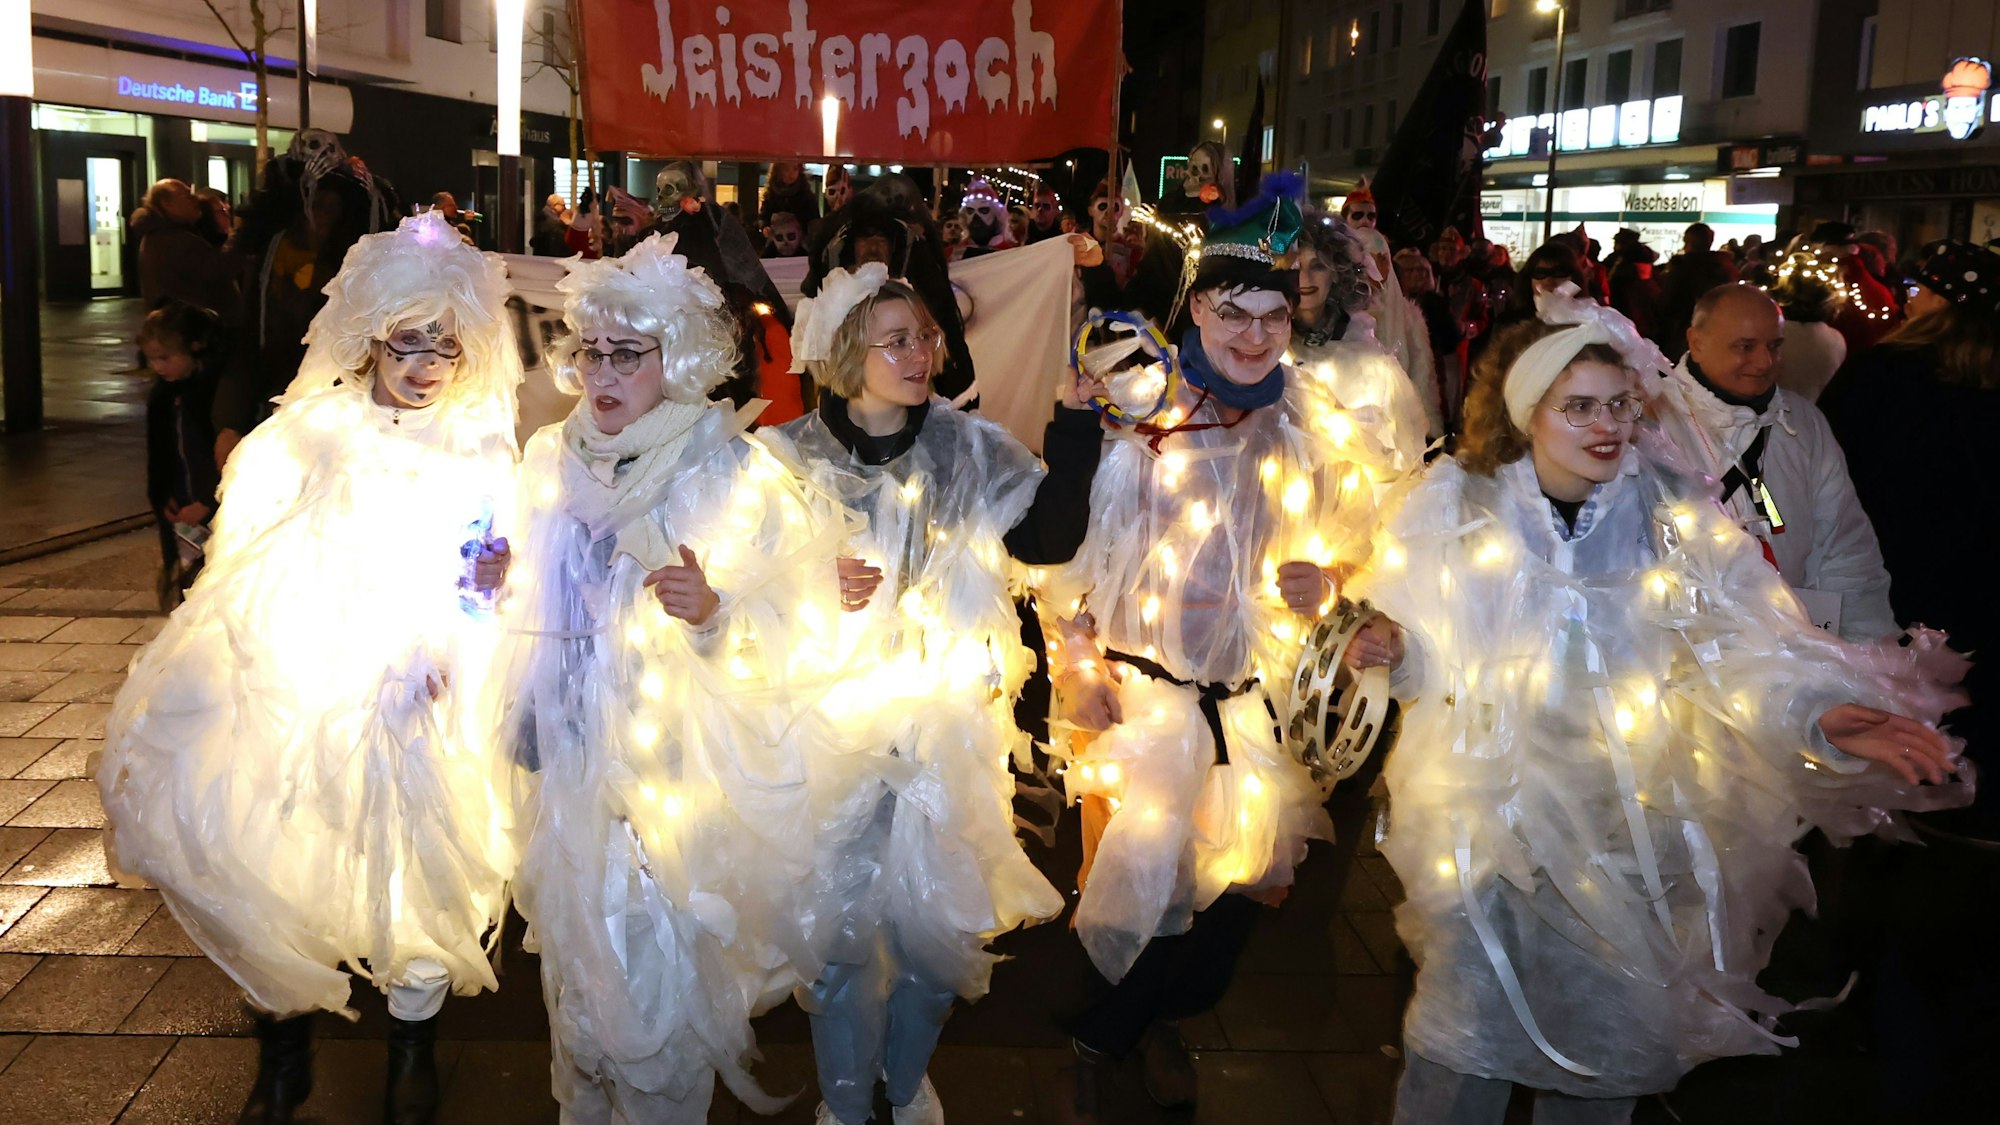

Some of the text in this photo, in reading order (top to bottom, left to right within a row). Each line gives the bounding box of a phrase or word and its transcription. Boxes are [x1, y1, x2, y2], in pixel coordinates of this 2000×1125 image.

[641, 0, 1057, 143] Jeisterzoch
[118, 76, 236, 109] Deutsche Bank
[1865, 100, 1940, 132] PABLO'S
[1624, 191, 1698, 212] Waschsalon
